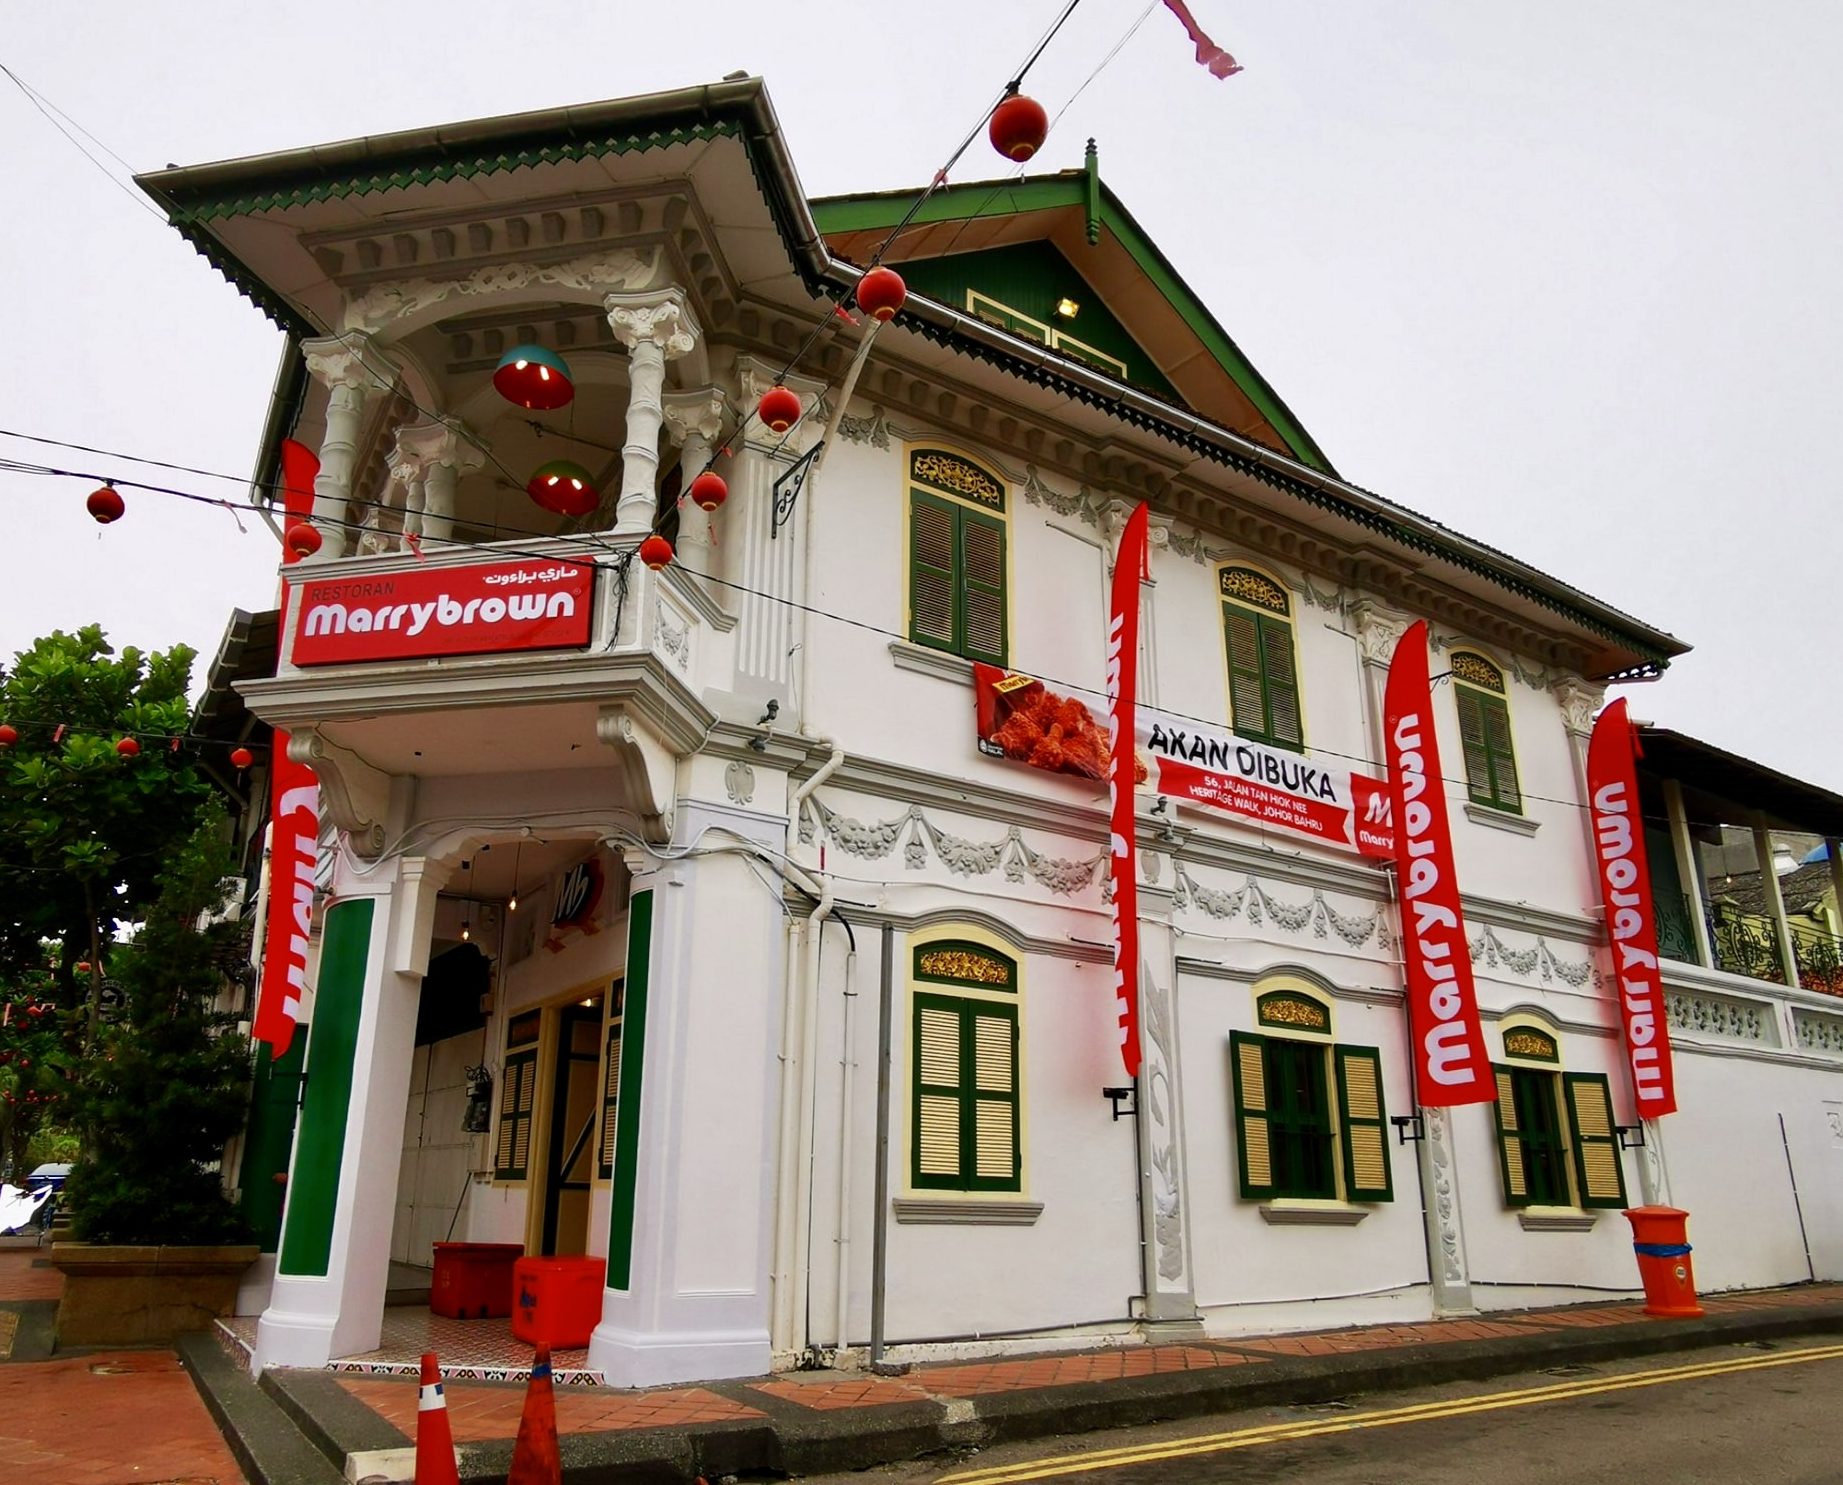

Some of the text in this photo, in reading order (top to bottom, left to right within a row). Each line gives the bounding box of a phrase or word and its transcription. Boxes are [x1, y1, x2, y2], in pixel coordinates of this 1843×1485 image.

[311, 582, 395, 602] RESTORAN
[1148, 723, 1337, 803] AKAN DIBUKA
[1189, 785, 1323, 832] HERITAGE WALK, JOHOR BAHRU
[1223, 779, 1249, 796] JALAN
[1250, 787, 1268, 802] TAN
[1269, 792, 1291, 809] HIOK
[1292, 801, 1308, 815] NEE
[1363, 792, 1393, 828] M
[1360, 829, 1394, 850] Marry
